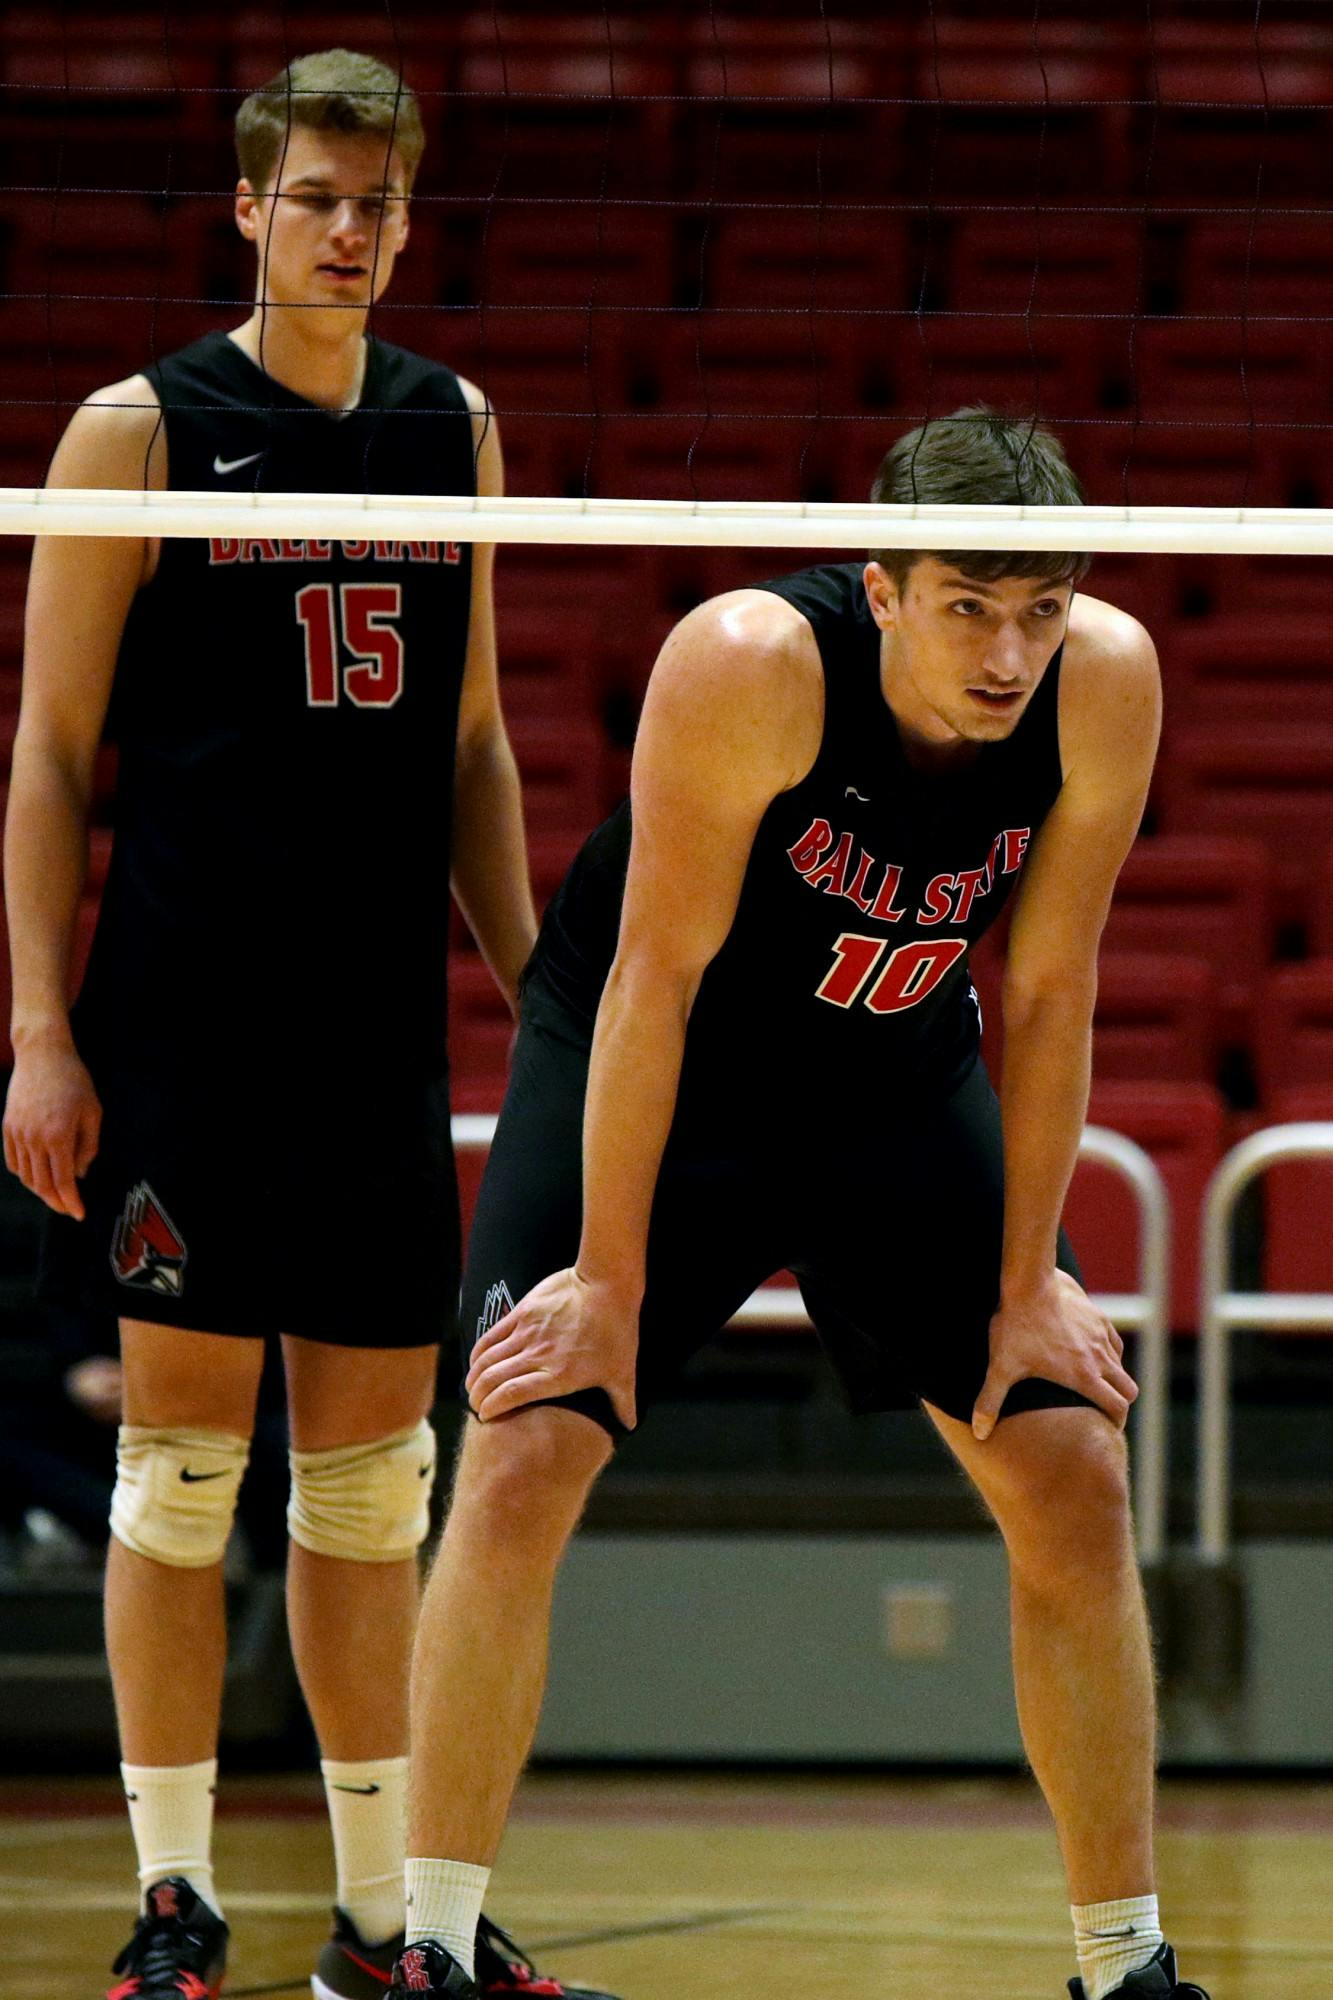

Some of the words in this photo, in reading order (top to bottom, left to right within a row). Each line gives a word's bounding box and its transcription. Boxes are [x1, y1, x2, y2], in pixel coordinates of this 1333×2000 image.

[295, 583, 404, 709] 15
[786, 818, 907, 923] BALL
[916, 827, 1031, 926] STTE
[814, 932, 968, 1015] 10
